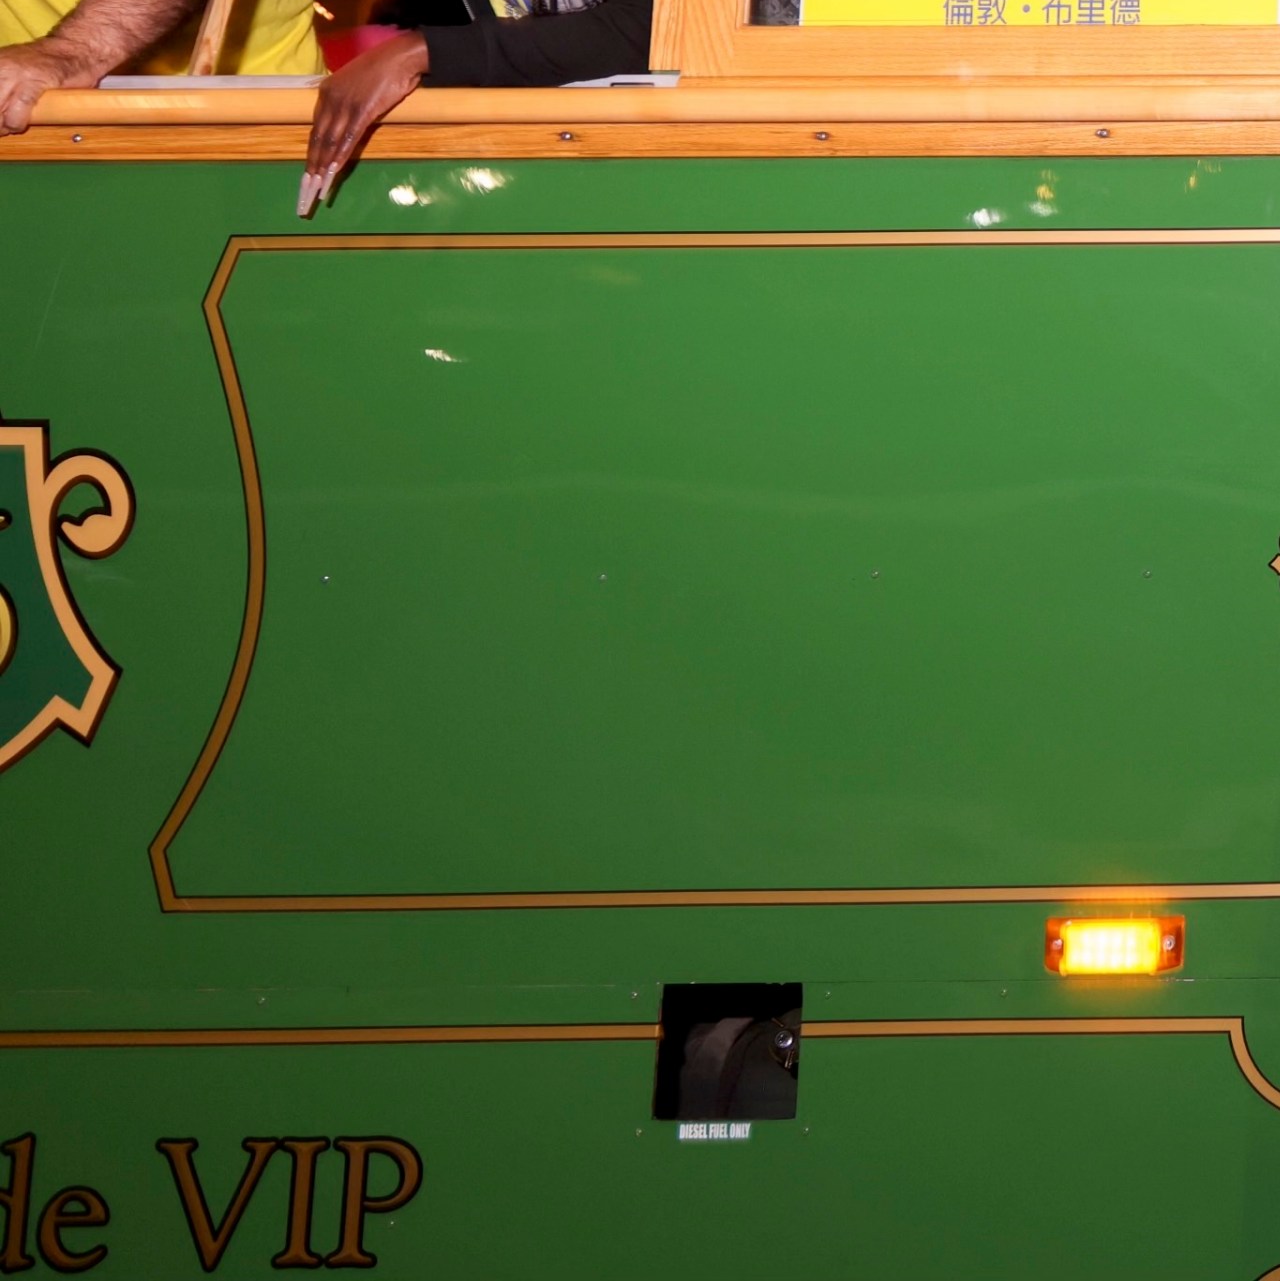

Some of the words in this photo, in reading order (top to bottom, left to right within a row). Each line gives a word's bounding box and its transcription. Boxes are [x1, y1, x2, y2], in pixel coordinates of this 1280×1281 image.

[679, 1123, 707, 1139] DIESEL
[709, 1123, 728, 1139] FUEL
[729, 1122, 751, 1138] ONLY
[156, 1135, 424, 1273] VIP
